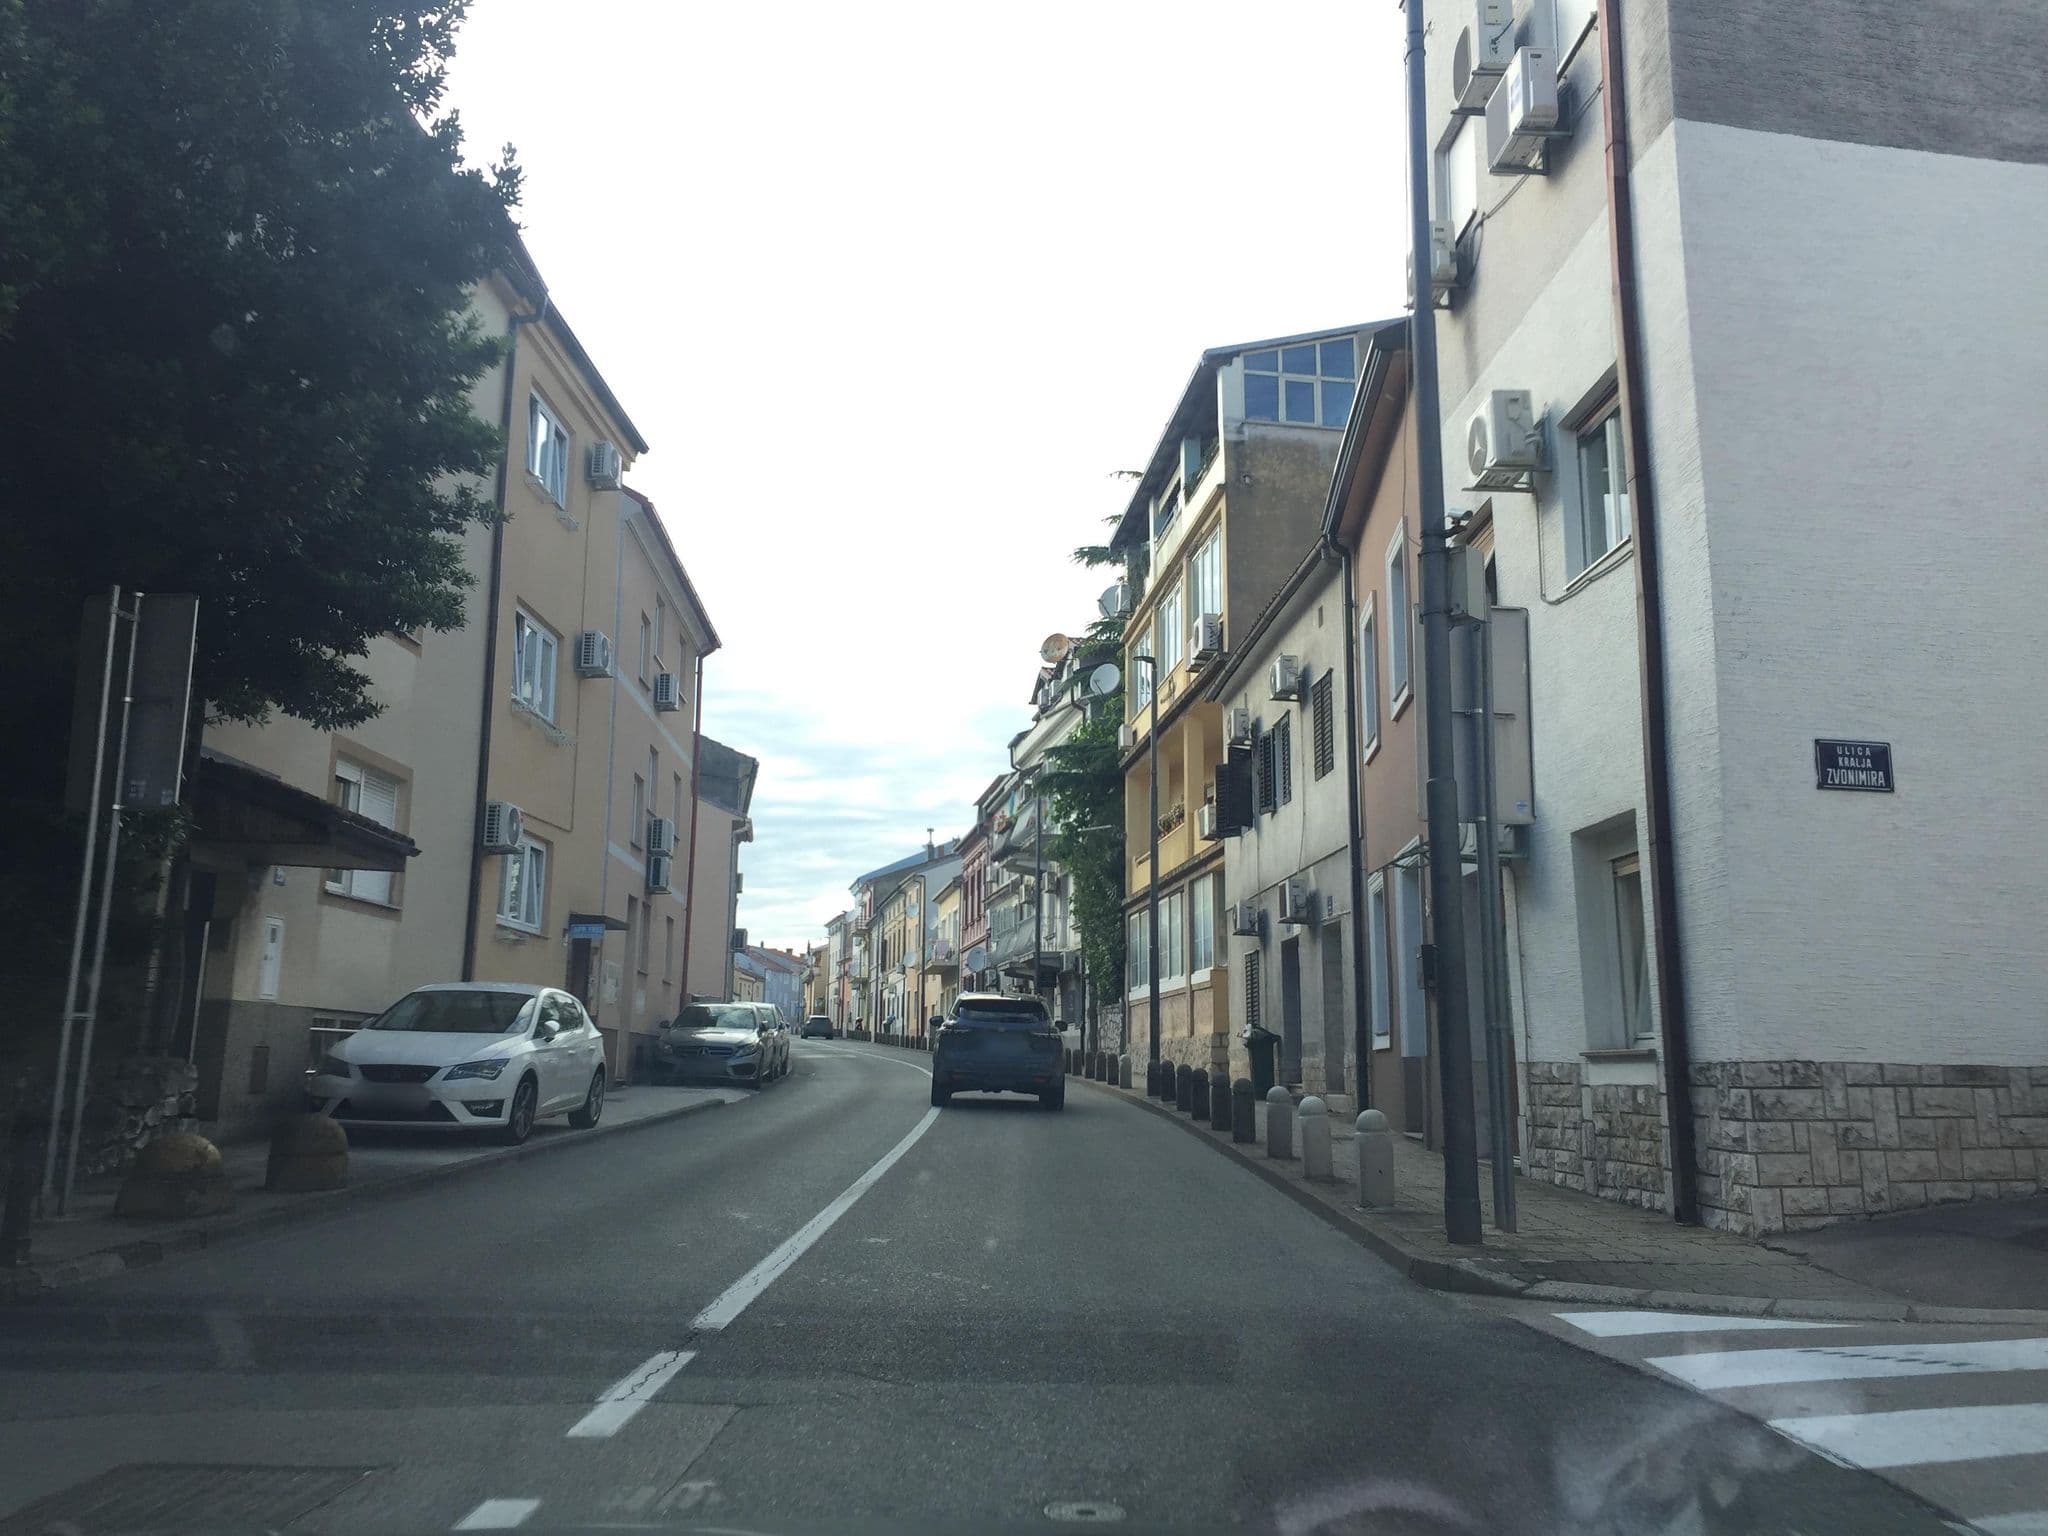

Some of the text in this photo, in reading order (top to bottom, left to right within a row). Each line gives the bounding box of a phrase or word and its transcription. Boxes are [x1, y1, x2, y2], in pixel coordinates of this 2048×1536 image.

[1837, 746, 1871, 756] ULICA
[1838, 757, 1872, 768] KRALJA
[1827, 768, 1885, 787] ZVONIMIRA
